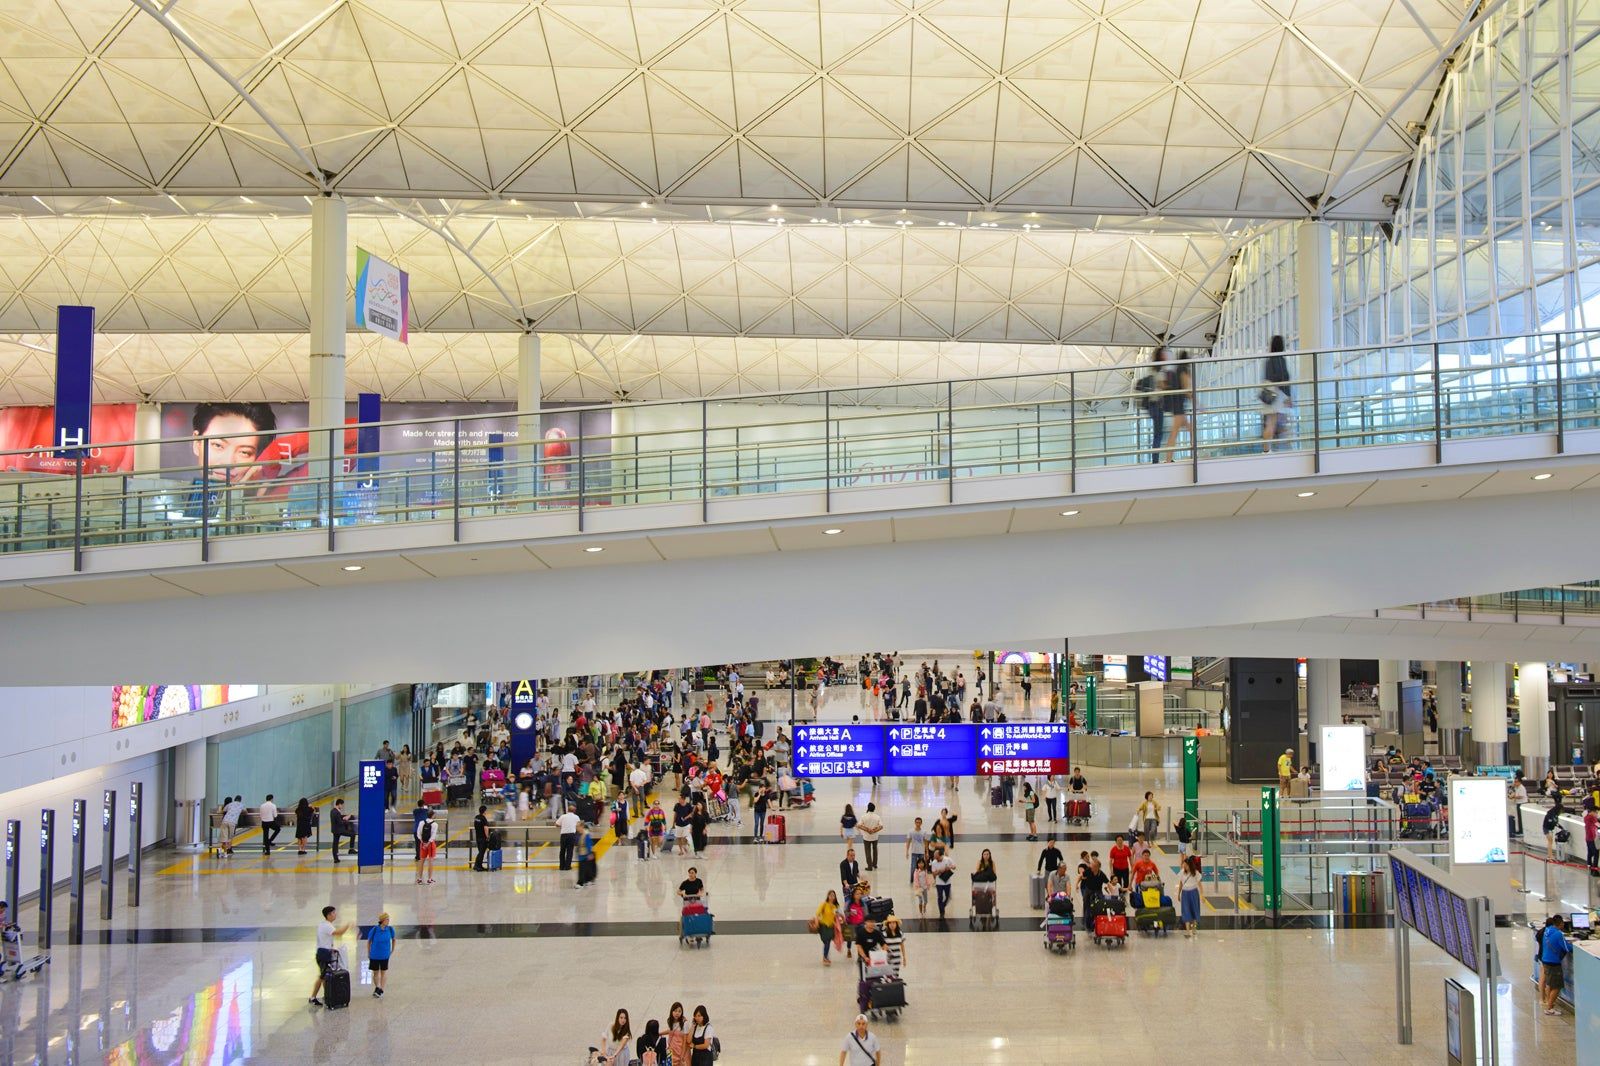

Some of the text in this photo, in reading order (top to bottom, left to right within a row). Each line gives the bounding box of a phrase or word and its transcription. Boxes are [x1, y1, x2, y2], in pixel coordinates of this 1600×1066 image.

[515, 680, 533, 695] A
[841, 729, 851, 740] A
[937, 728, 946, 739] 4
[132, 784, 136, 793] 1
[105, 792, 110, 802] 2
[74, 802, 79, 812] 3
[42, 811, 47, 821] 4
[8, 822, 13, 833] 5
